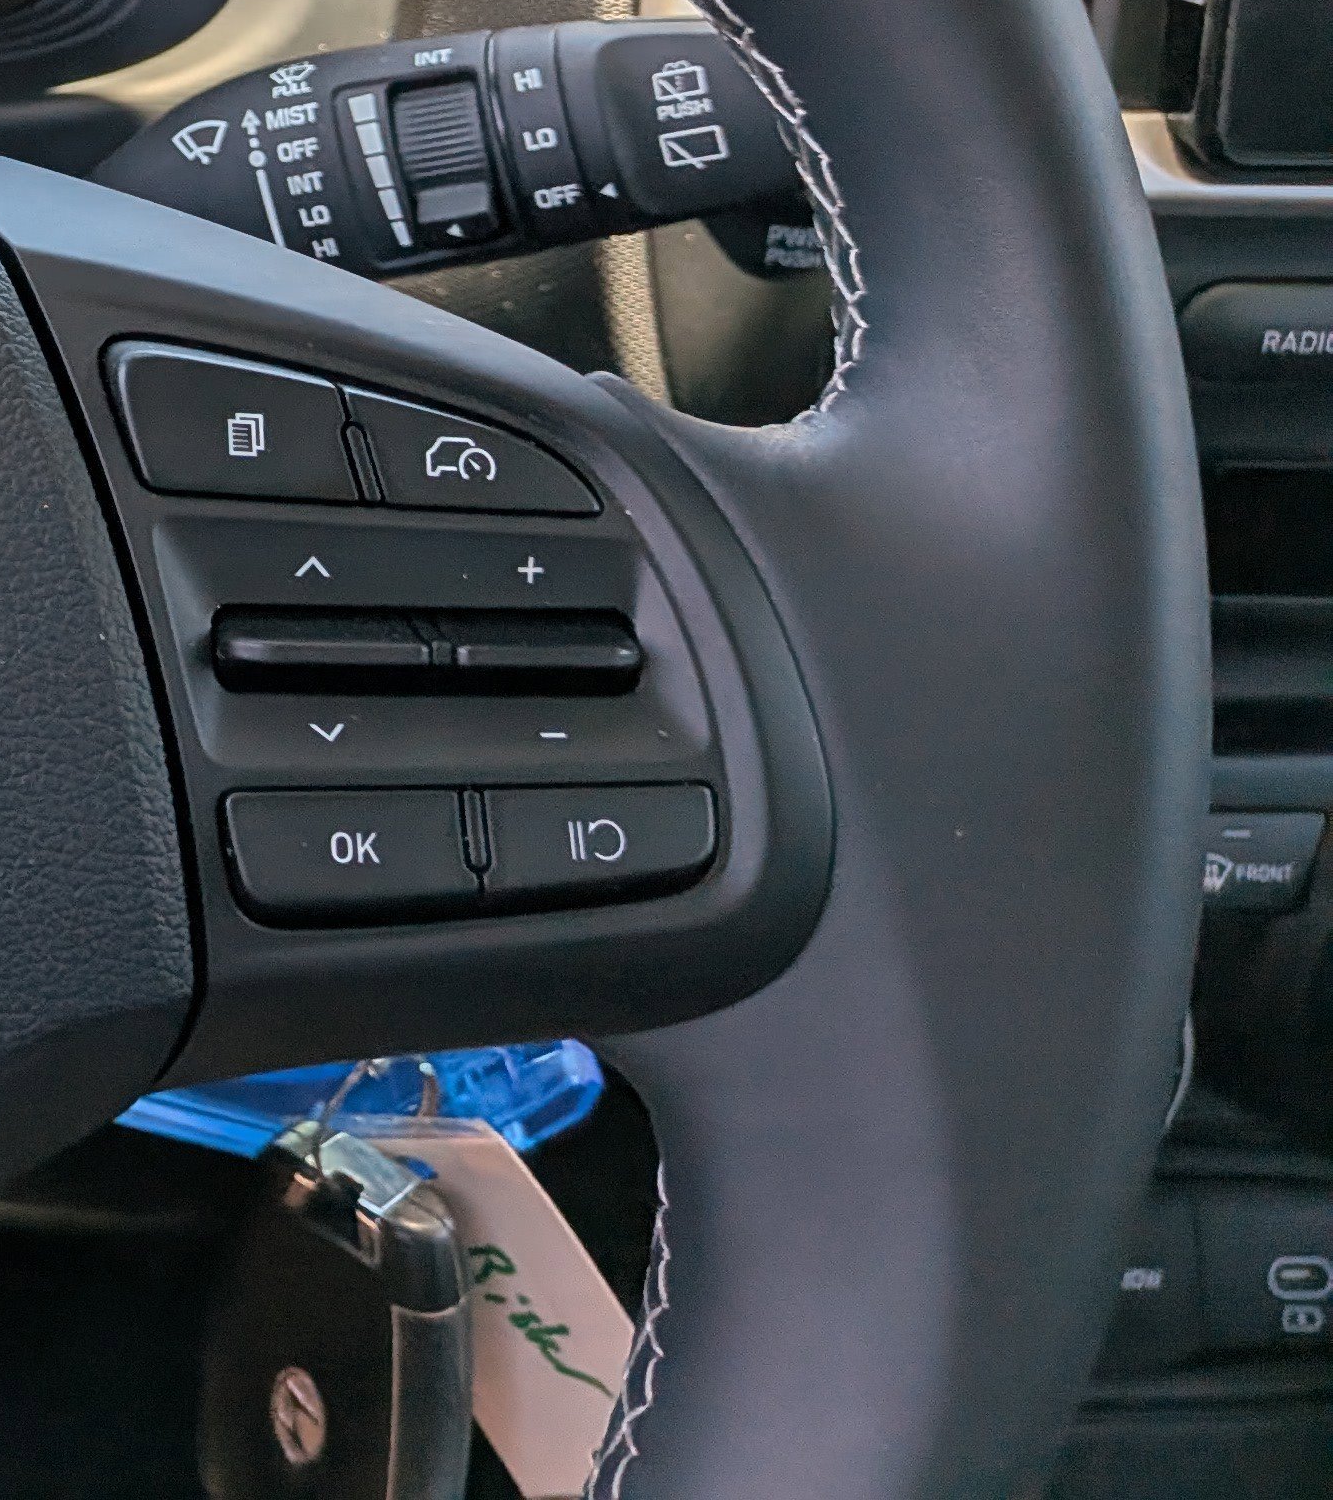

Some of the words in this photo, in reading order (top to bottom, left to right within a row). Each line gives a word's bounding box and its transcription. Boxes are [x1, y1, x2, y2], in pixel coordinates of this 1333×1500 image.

[414, 48, 453, 67] INT
[271, 80, 312, 99] PULL
[512, 67, 544, 93] HI
[264, 101, 318, 131] MIST
[656, 97, 714, 121] PUSH
[276, 137, 320, 163] OFF
[522, 126, 559, 152] LO
[286, 171, 324, 196] INT
[533, 183, 583, 209] OFF
[298, 204, 332, 227] LO
[311, 236, 341, 259] HI
[330, 831, 381, 864] OK
[1235, 863, 1294, 883] FRONT
